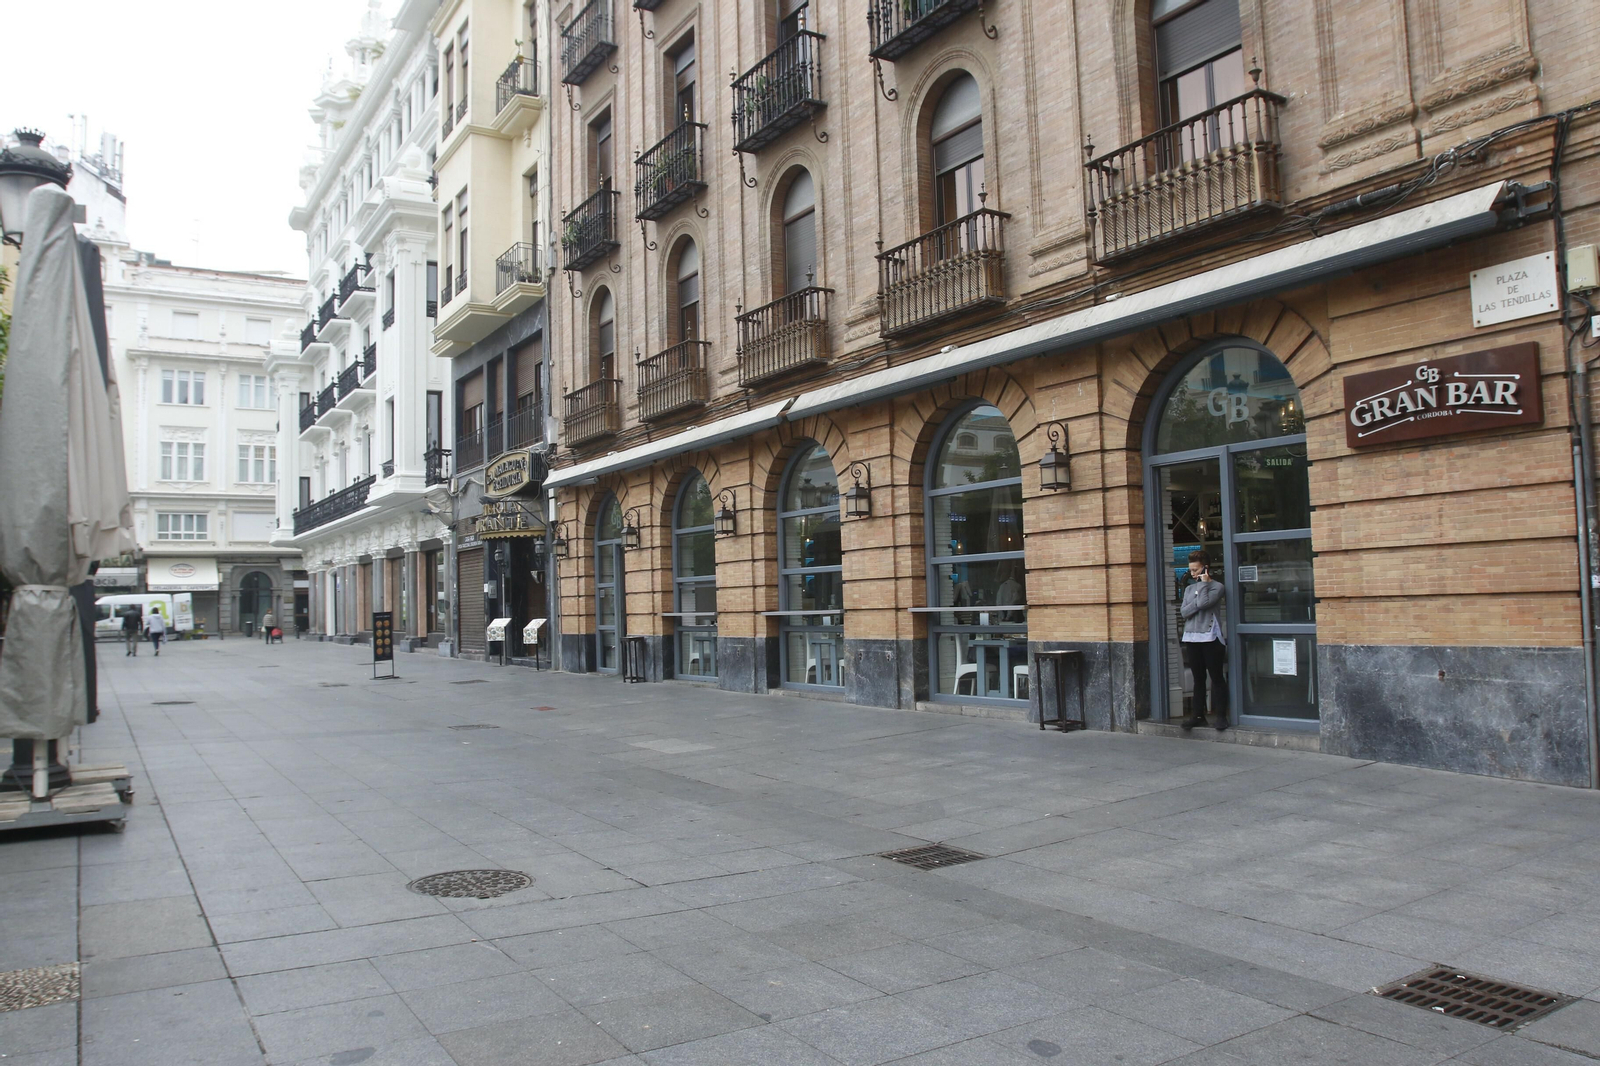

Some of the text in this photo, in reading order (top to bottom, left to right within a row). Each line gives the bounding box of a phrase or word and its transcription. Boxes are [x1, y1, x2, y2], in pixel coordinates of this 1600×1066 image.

[1496, 270, 1528, 285] PLAZA
[1507, 285, 1519, 295] DE
[1478, 290, 1551, 313] LAS TENDILLAS
[1415, 365, 1440, 383] GB
[1207, 387, 1250, 423] GB
[1350, 380, 1519, 427] GRAN BAR
[1266, 458, 1293, 466] SALIDA
